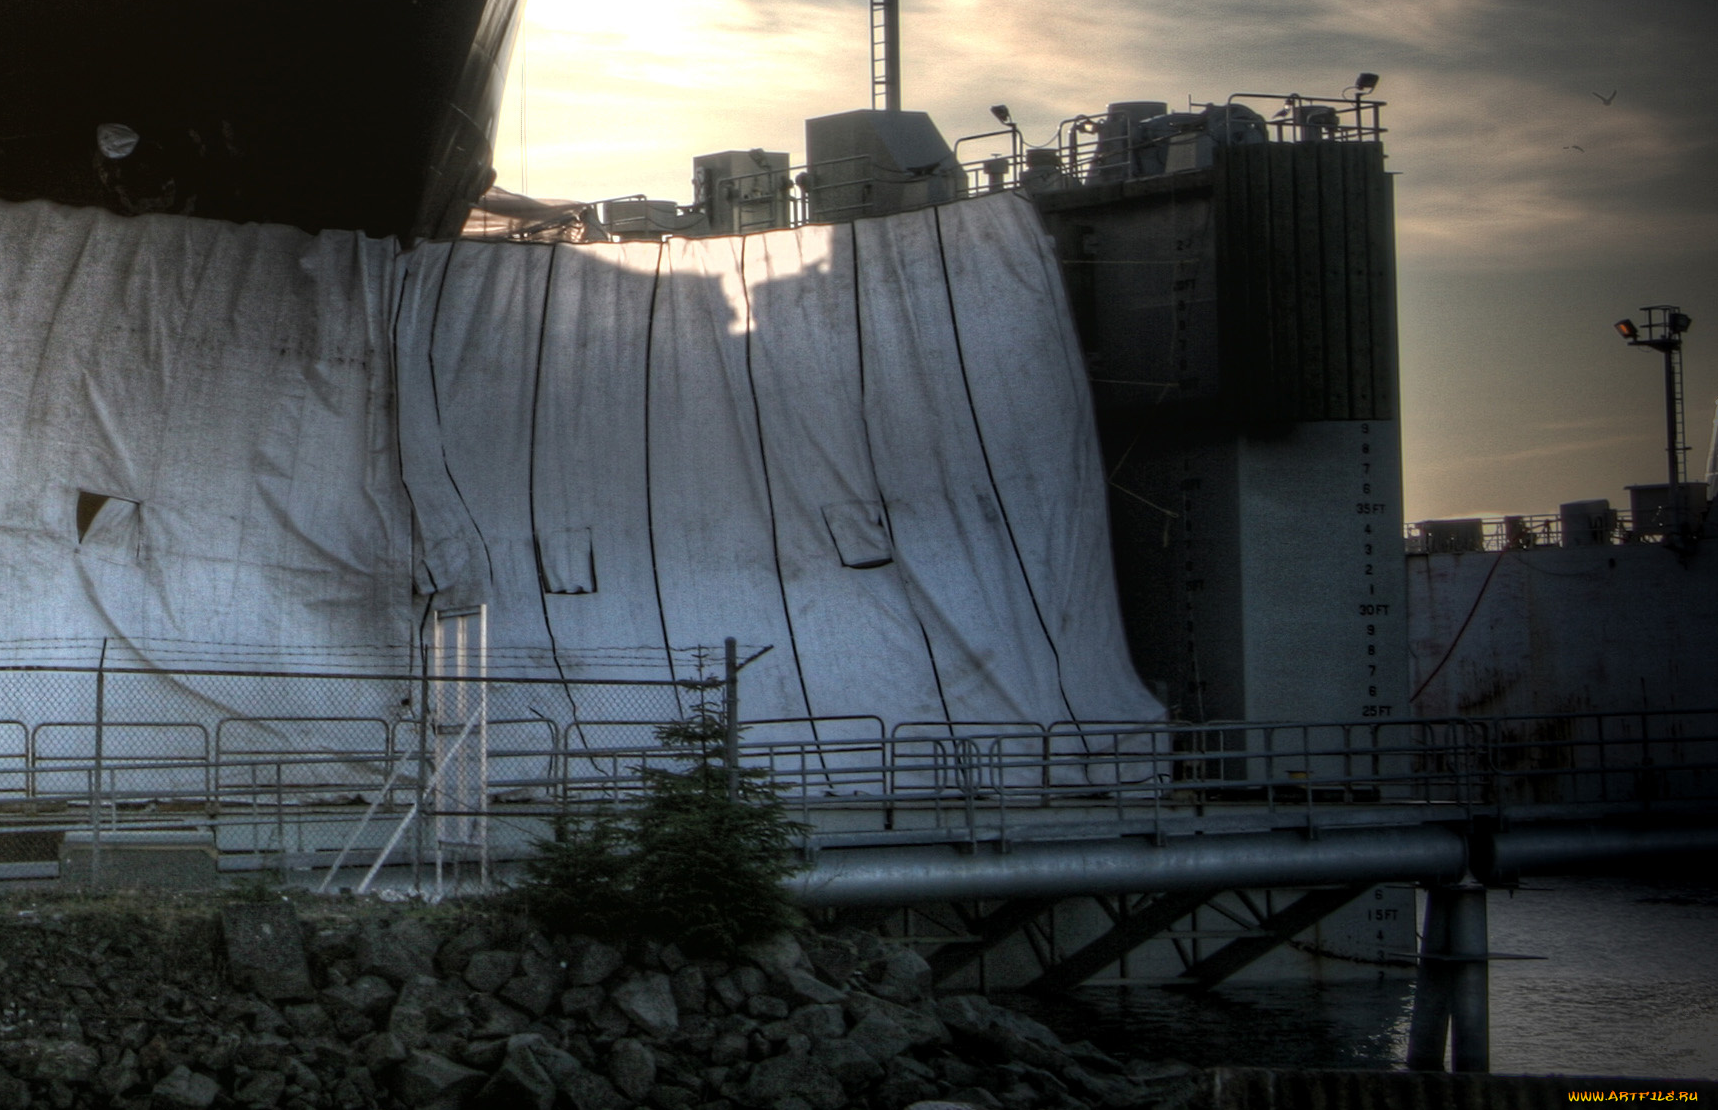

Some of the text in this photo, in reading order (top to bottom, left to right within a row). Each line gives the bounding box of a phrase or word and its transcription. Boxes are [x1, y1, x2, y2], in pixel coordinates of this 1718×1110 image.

[1363, 483, 1370, 494] 6
[1364, 524, 1371, 535] 4
[1365, 544, 1372, 555] 3
[1365, 564, 1373, 575] 2
[1367, 625, 1375, 636] 9
[1368, 645, 1375, 656] 8
[1368, 665, 1376, 676] 7
[1369, 686, 1376, 697] 6
[1375, 889, 1383, 900] 6
[1376, 930, 1383, 941] 4
